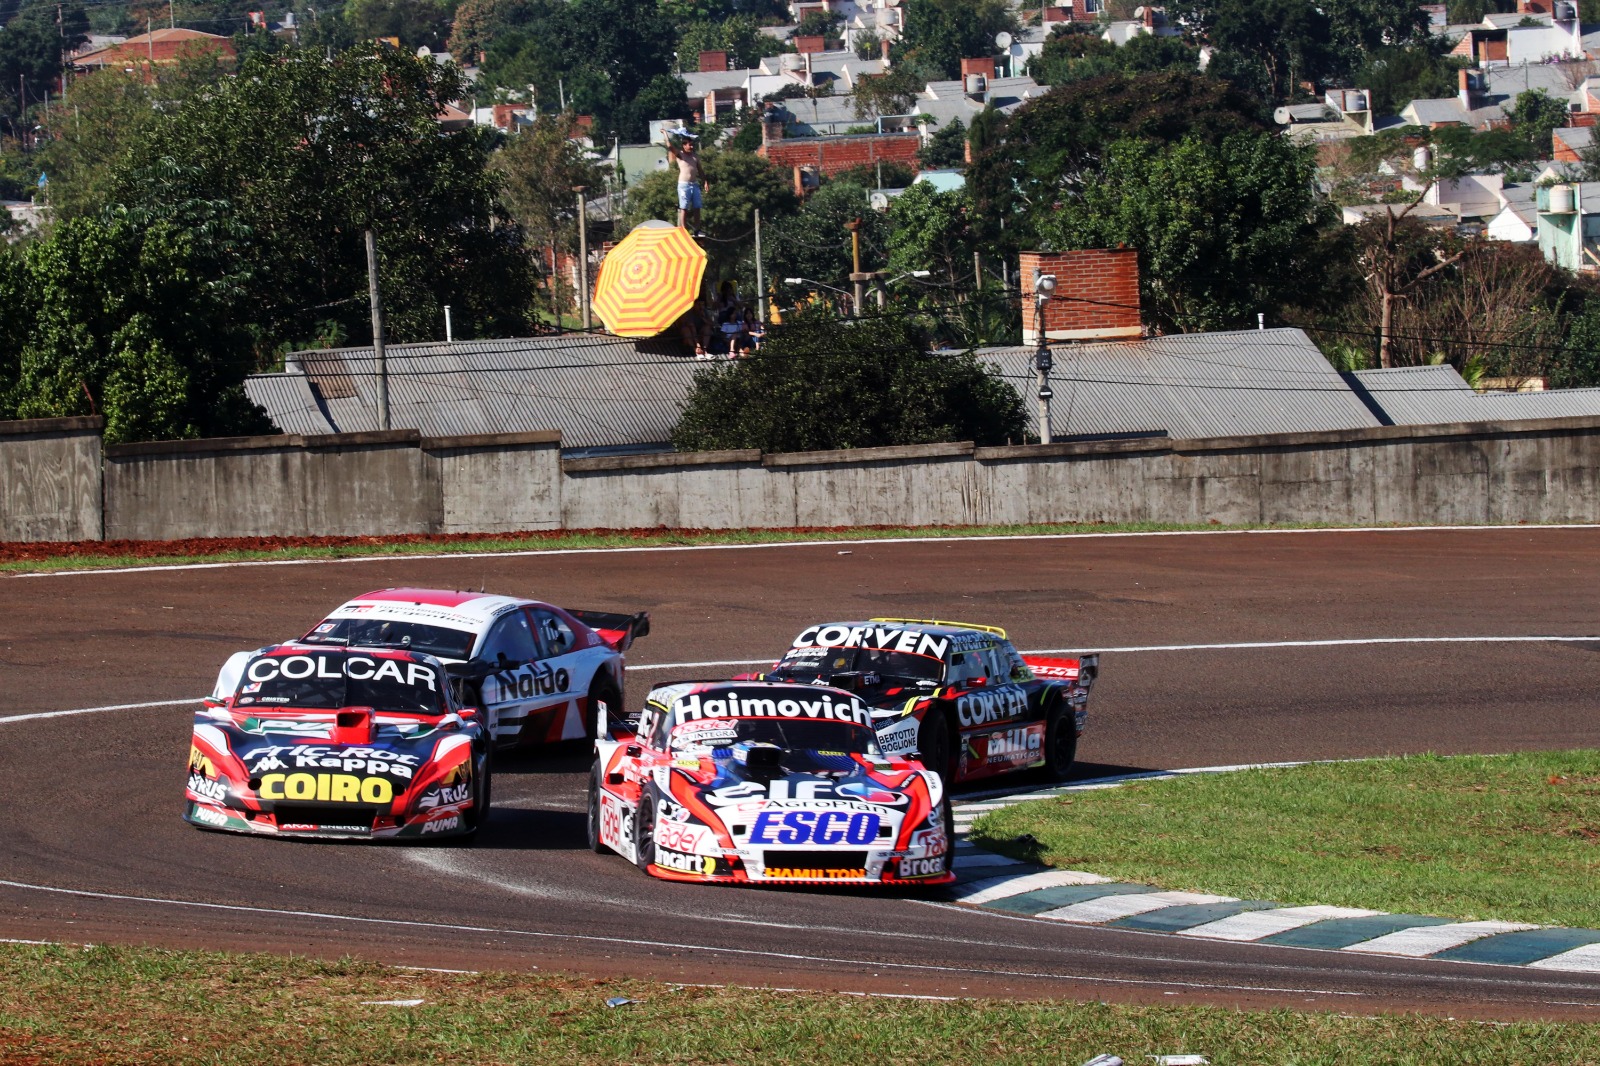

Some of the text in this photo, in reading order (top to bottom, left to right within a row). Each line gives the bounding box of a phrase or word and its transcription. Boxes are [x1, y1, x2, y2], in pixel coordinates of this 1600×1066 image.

[793, 626, 948, 659] CORVEN
[247, 656, 437, 692] COLCAR
[674, 692, 873, 730] Haimovich
[878, 727, 915, 745] BERTOTTO
[881, 737, 917, 753] BOGLIONE
[988, 727, 1041, 756] milla
[295, 755, 413, 779] Kappa
[260, 773, 394, 804] COIRO
[421, 816, 459, 835] PUMA
[748, 811, 881, 845] ESCO
[765, 867, 867, 879] HAMILTON
